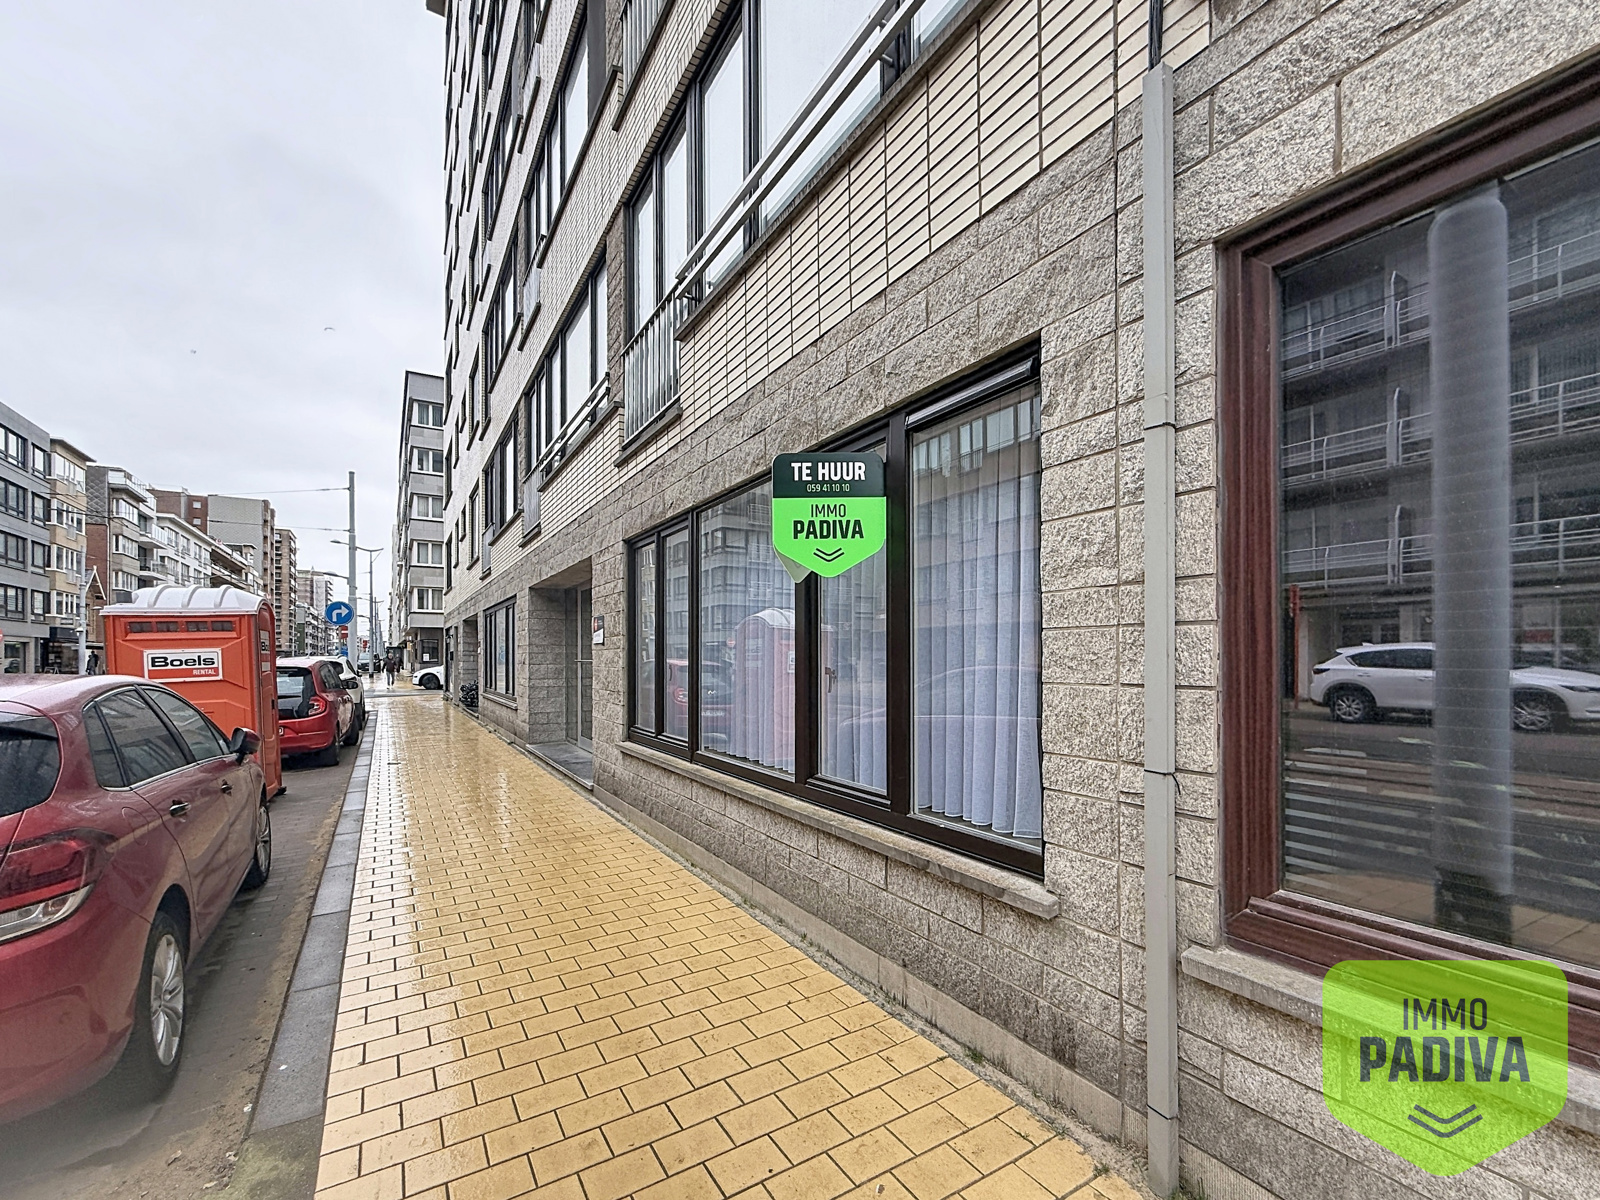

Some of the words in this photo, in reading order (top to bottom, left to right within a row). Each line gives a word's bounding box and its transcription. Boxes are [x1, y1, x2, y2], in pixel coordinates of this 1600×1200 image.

[791, 462, 812, 481] TE
[817, 462, 866, 481] HUUR
[806, 483, 821, 492] 059
[822, 483, 831, 492] 41
[831, 483, 840, 492] 10
[841, 483, 850, 492] 10
[810, 503, 847, 518] IMMO
[793, 519, 864, 540] PADIVA
[150, 655, 216, 667] Boels
